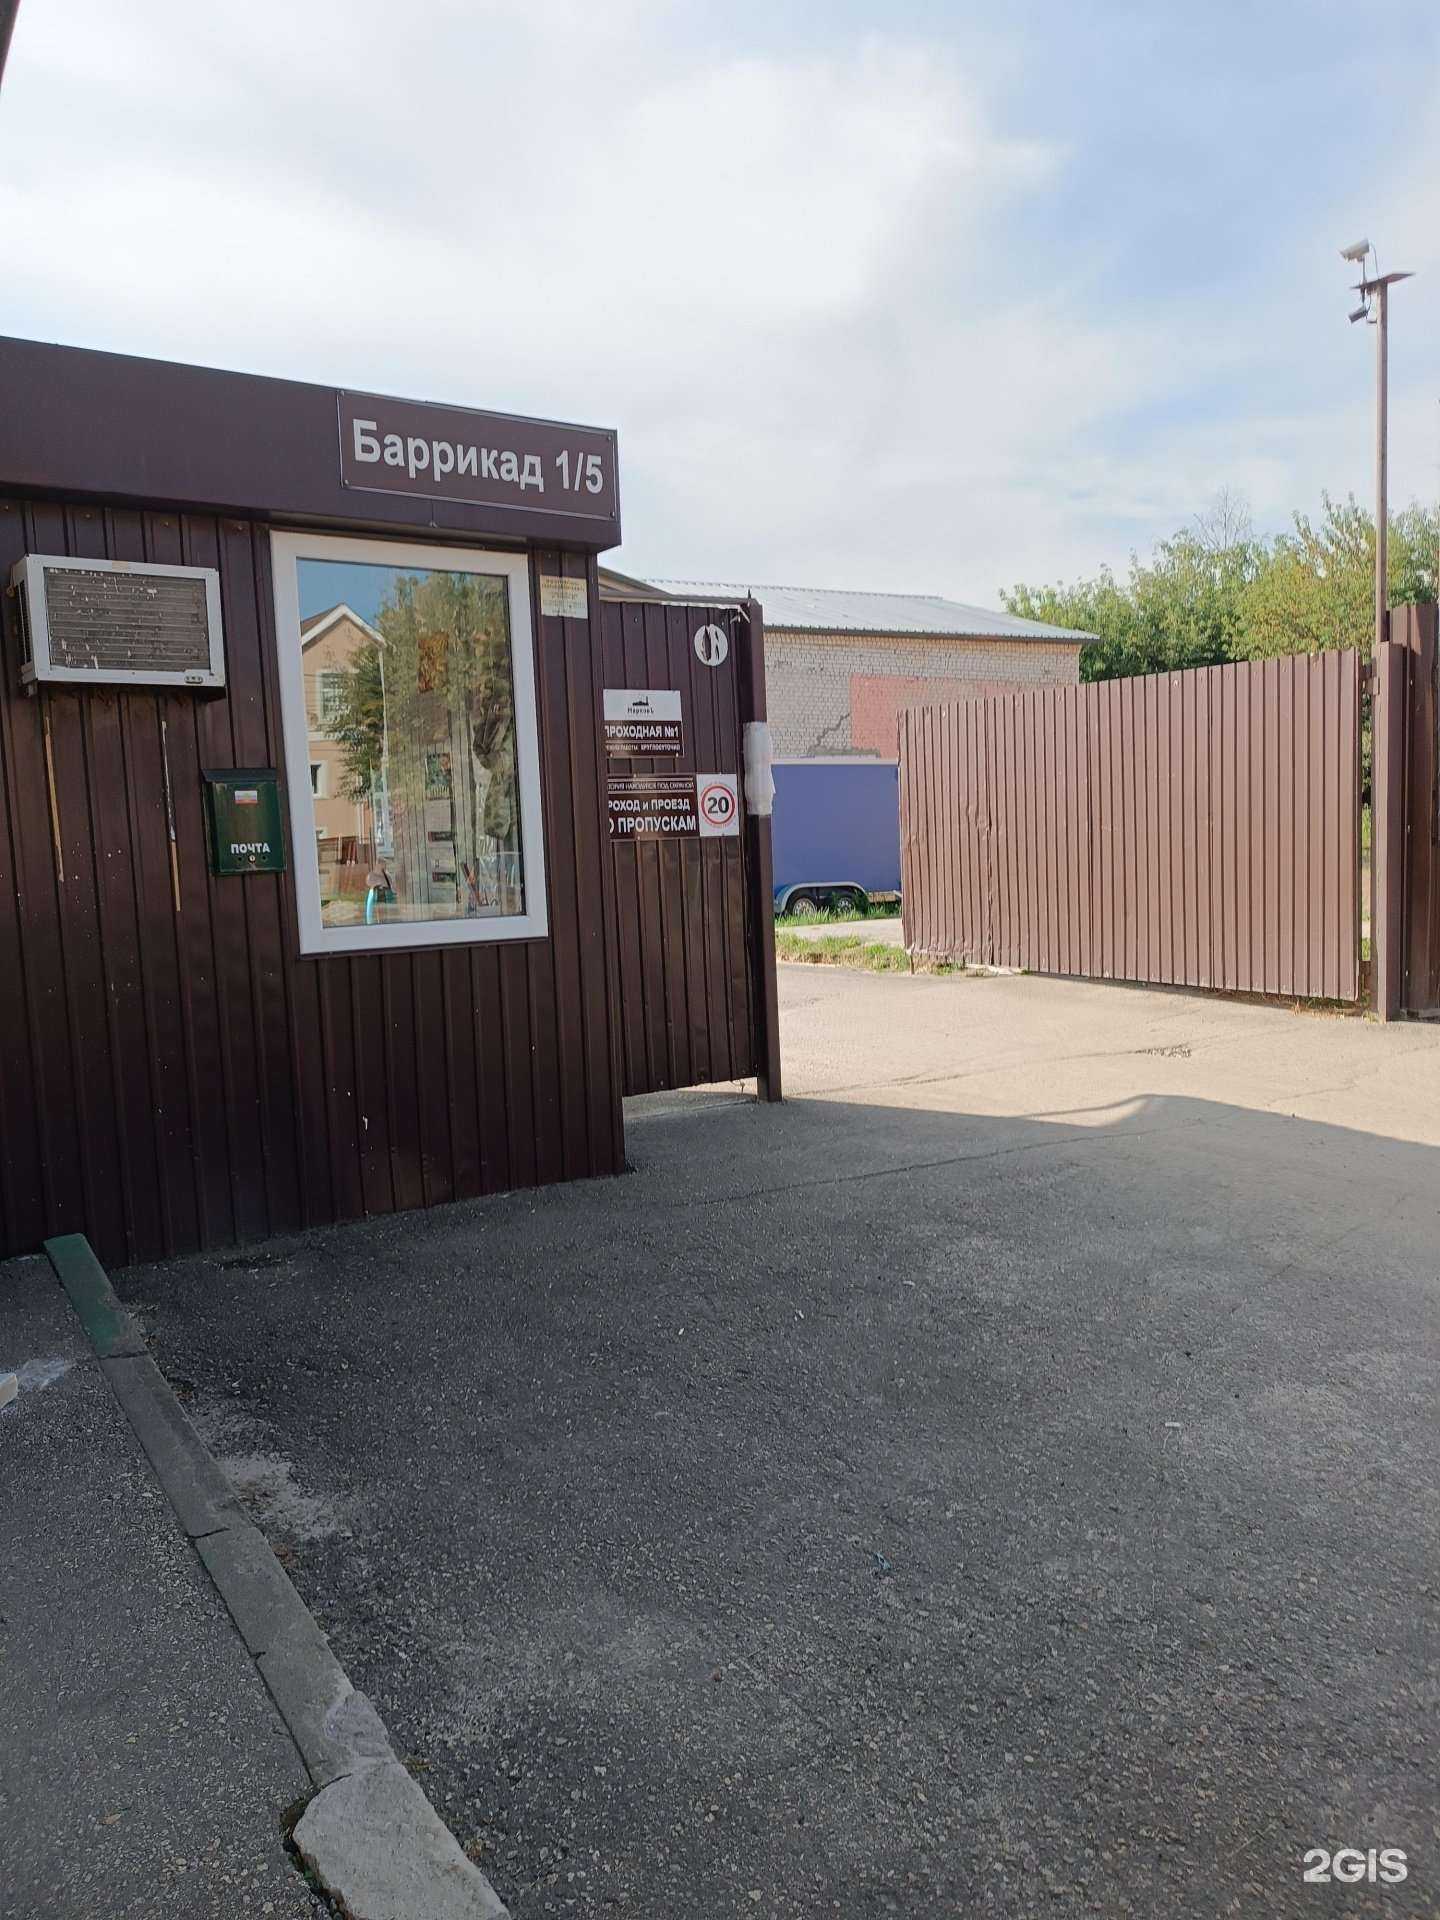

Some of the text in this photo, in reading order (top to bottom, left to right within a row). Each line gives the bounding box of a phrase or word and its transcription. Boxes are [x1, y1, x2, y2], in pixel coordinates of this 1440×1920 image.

[353, 418, 604, 494] Баррикад 1/5
[608, 799, 640, 813] РОХОД
[651, 799, 690, 812] ПРОЕЗД
[707, 796, 730, 814] 20
[618, 815, 696, 833] ПРОПУСКАМ
[231, 842, 271, 854] ПОЧТА
